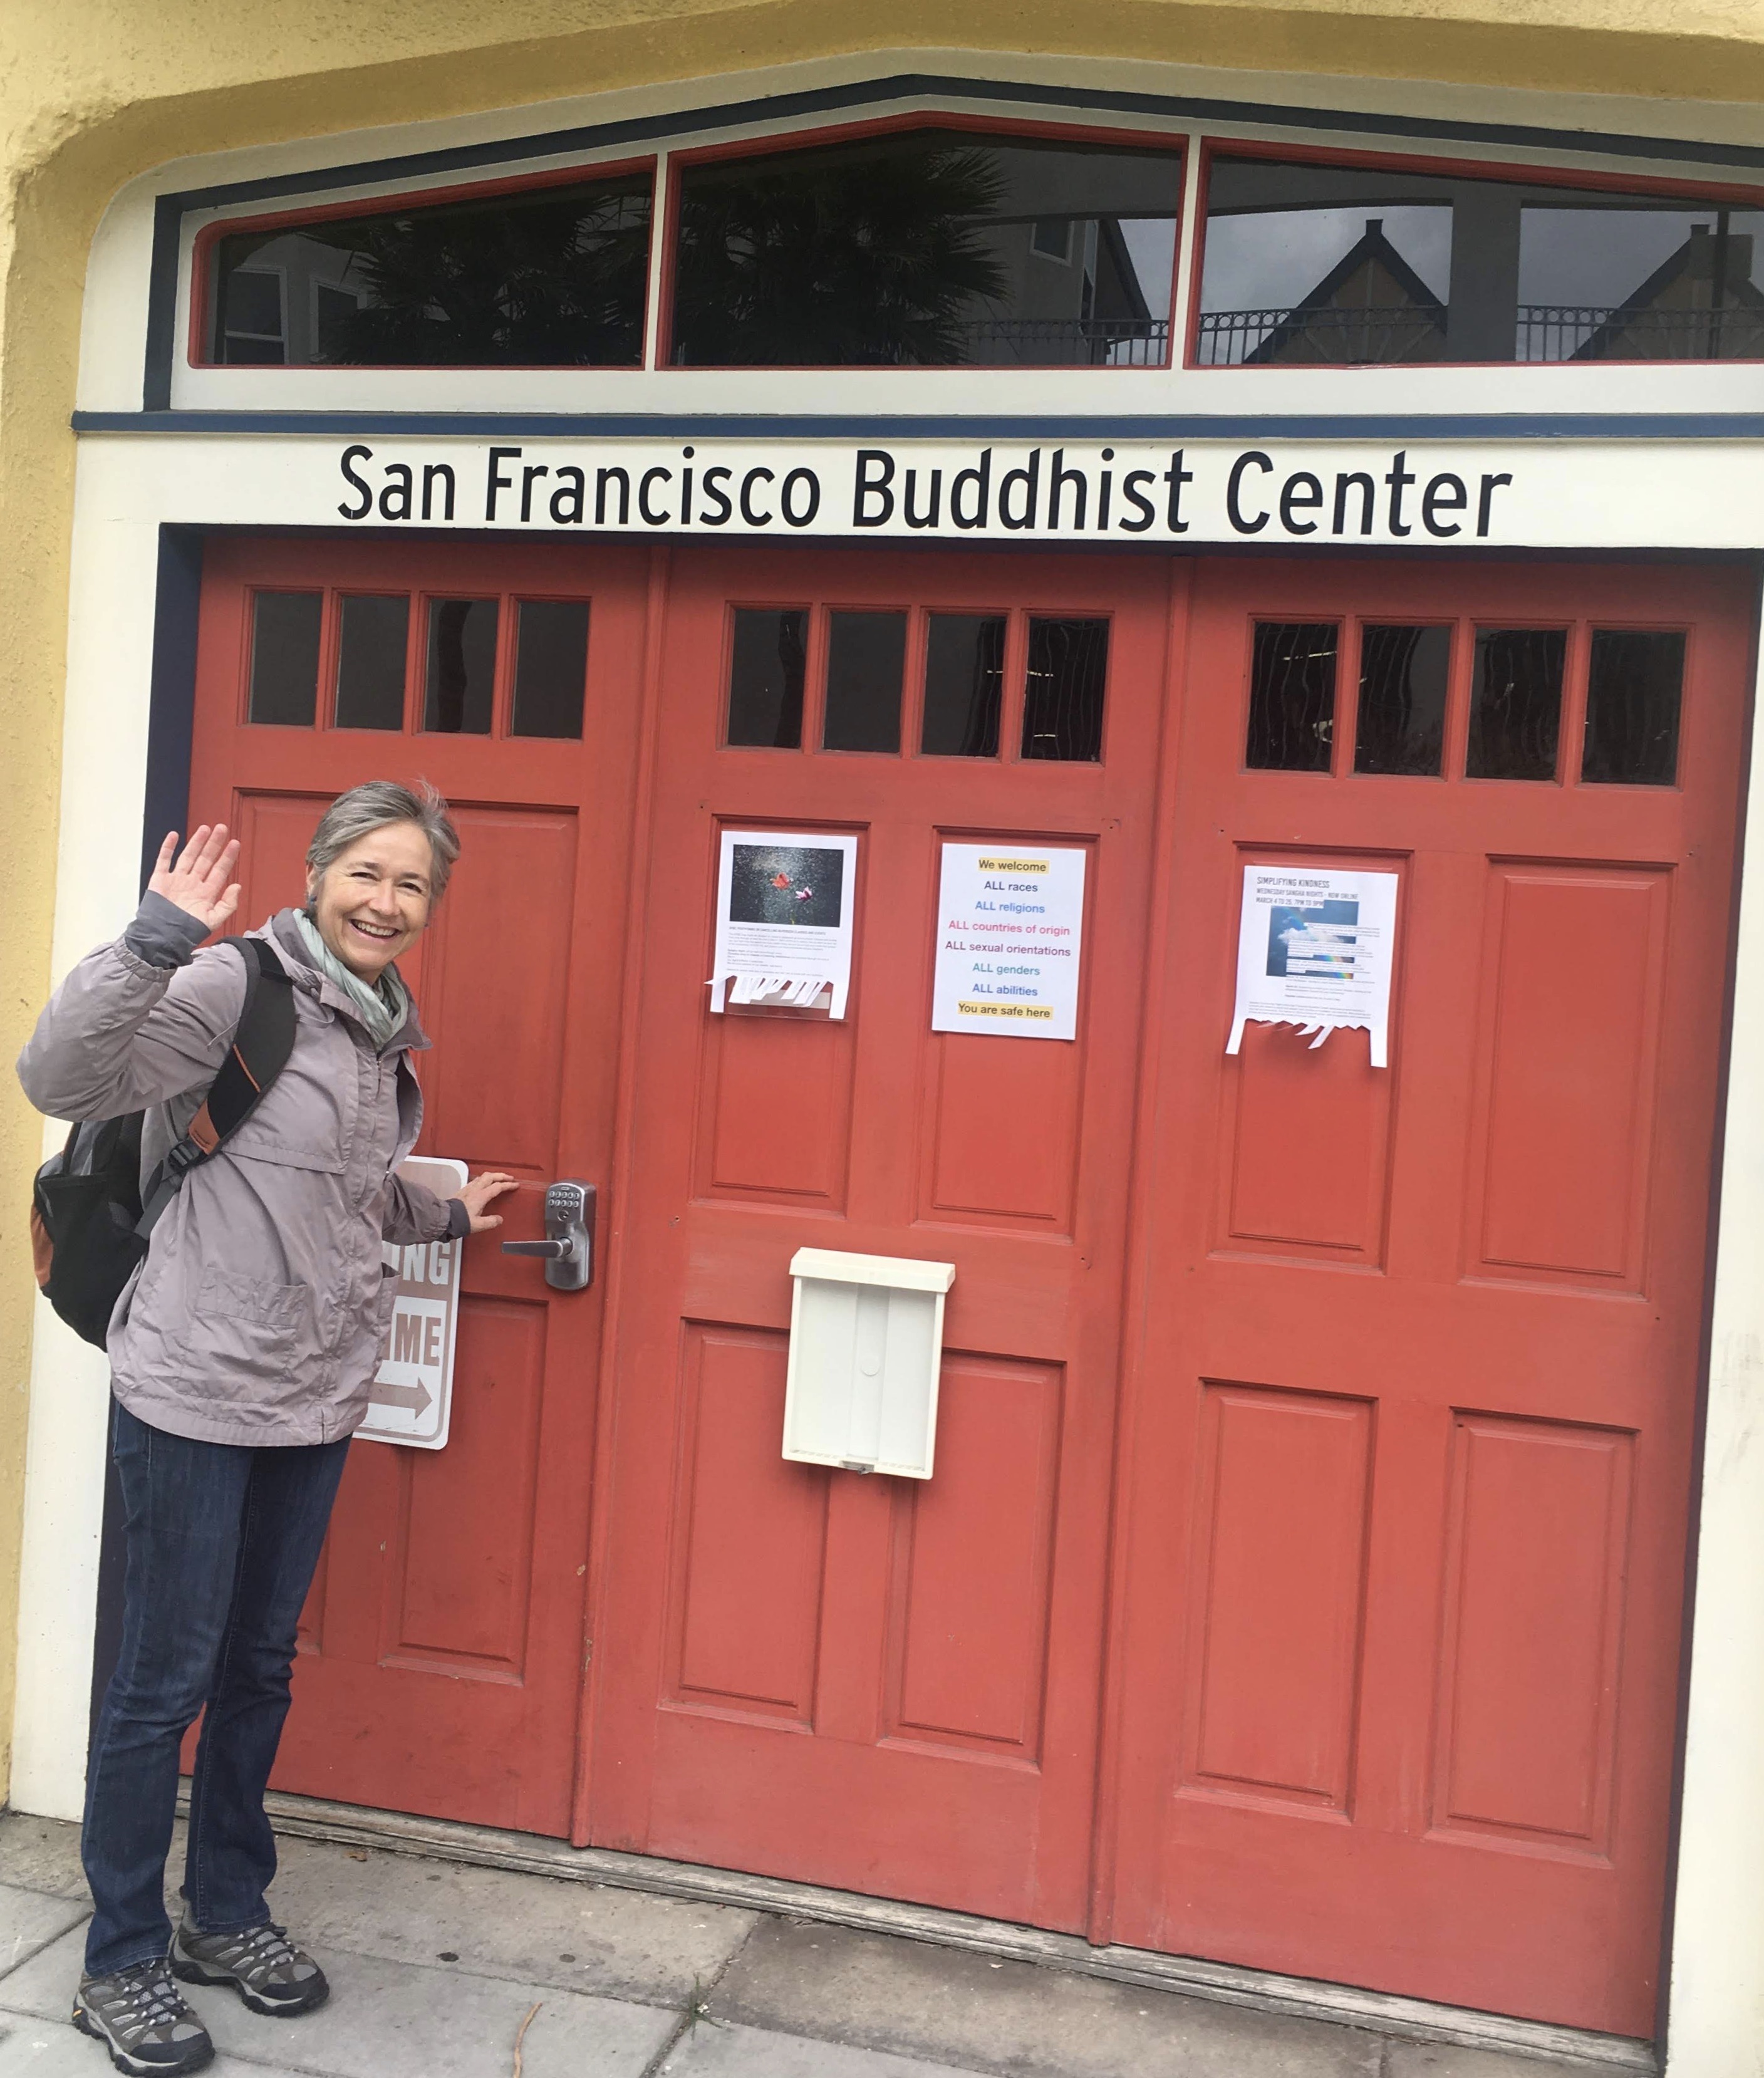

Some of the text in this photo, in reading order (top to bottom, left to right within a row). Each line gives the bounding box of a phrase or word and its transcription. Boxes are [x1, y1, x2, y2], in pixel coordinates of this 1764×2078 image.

[338, 445, 1513, 538] San Francisco Buddhist Center
[978, 859, 1047, 871] We welcome
[983, 880, 1039, 892] ALL races
[1257, 876, 1331, 888] SIMPLIFYING KINDNESS
[975, 900, 1045, 915] ALL religions
[948, 920, 1071, 937] ALL countries of origin
[945, 940, 1071, 957] ALL sexual orientations
[972, 962, 1040, 976] ALL genders
[972, 983, 1038, 997] ALL abilities
[958, 1002, 1051, 1018] You are safe here
